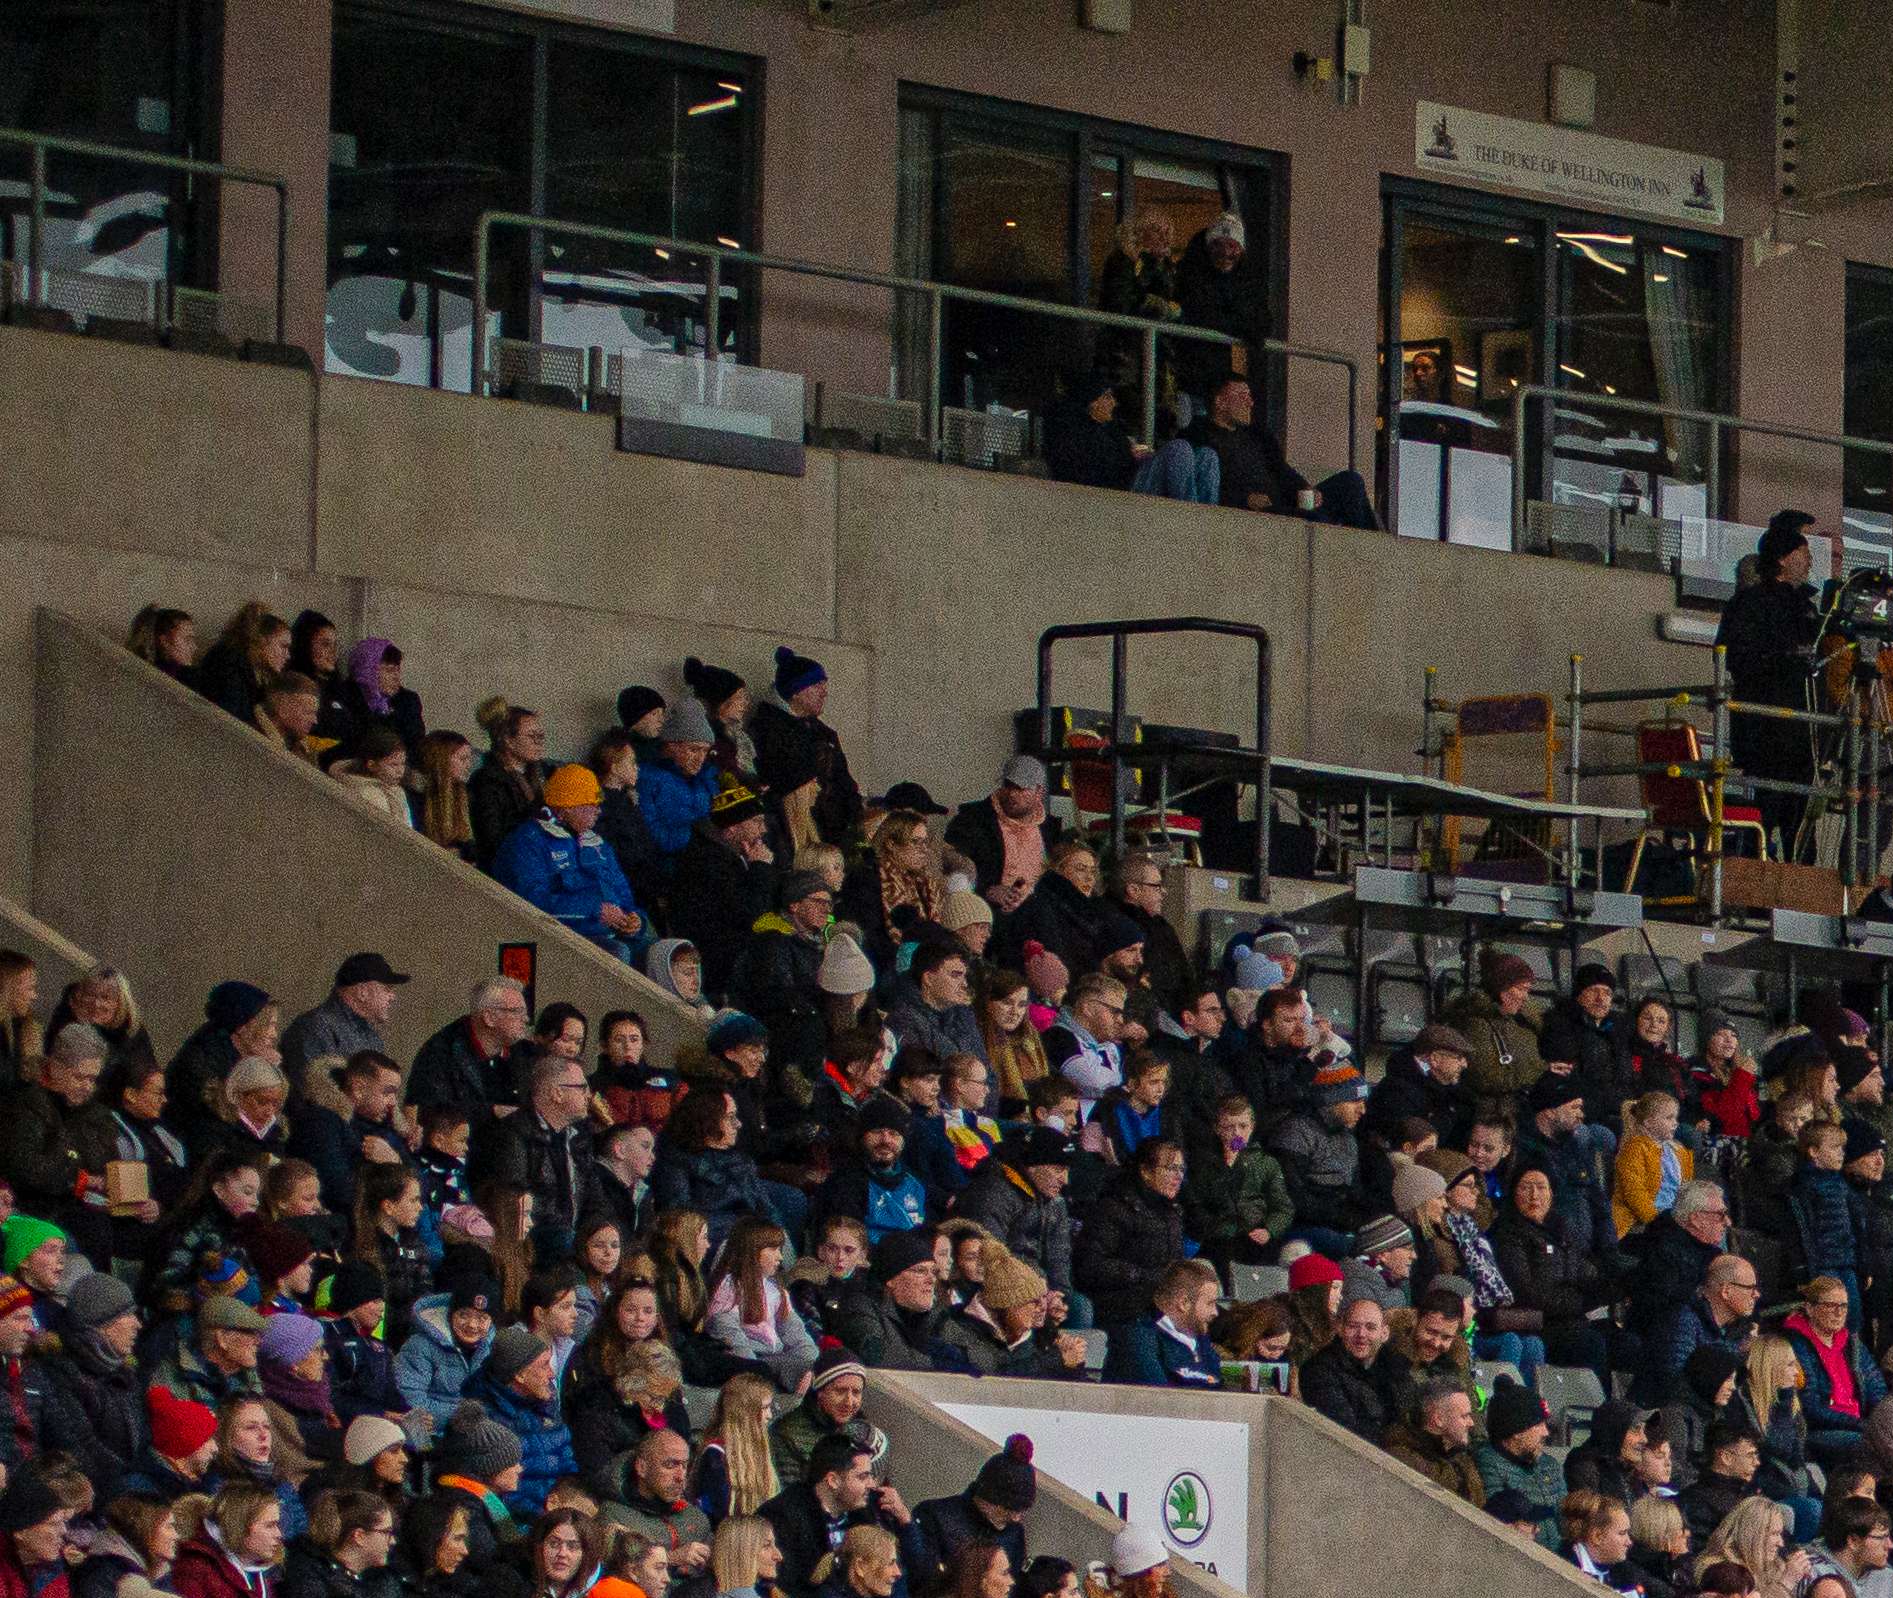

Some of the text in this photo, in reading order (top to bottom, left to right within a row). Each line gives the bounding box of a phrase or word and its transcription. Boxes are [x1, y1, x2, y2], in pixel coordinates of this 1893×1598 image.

[1474, 144, 1500, 163] THE
[1503, 149, 1539, 171] DUKE
[1542, 155, 1560, 173] OF
[1563, 158, 1645, 194] WELLINGTON
[1873, 599, 1888, 617] 4
